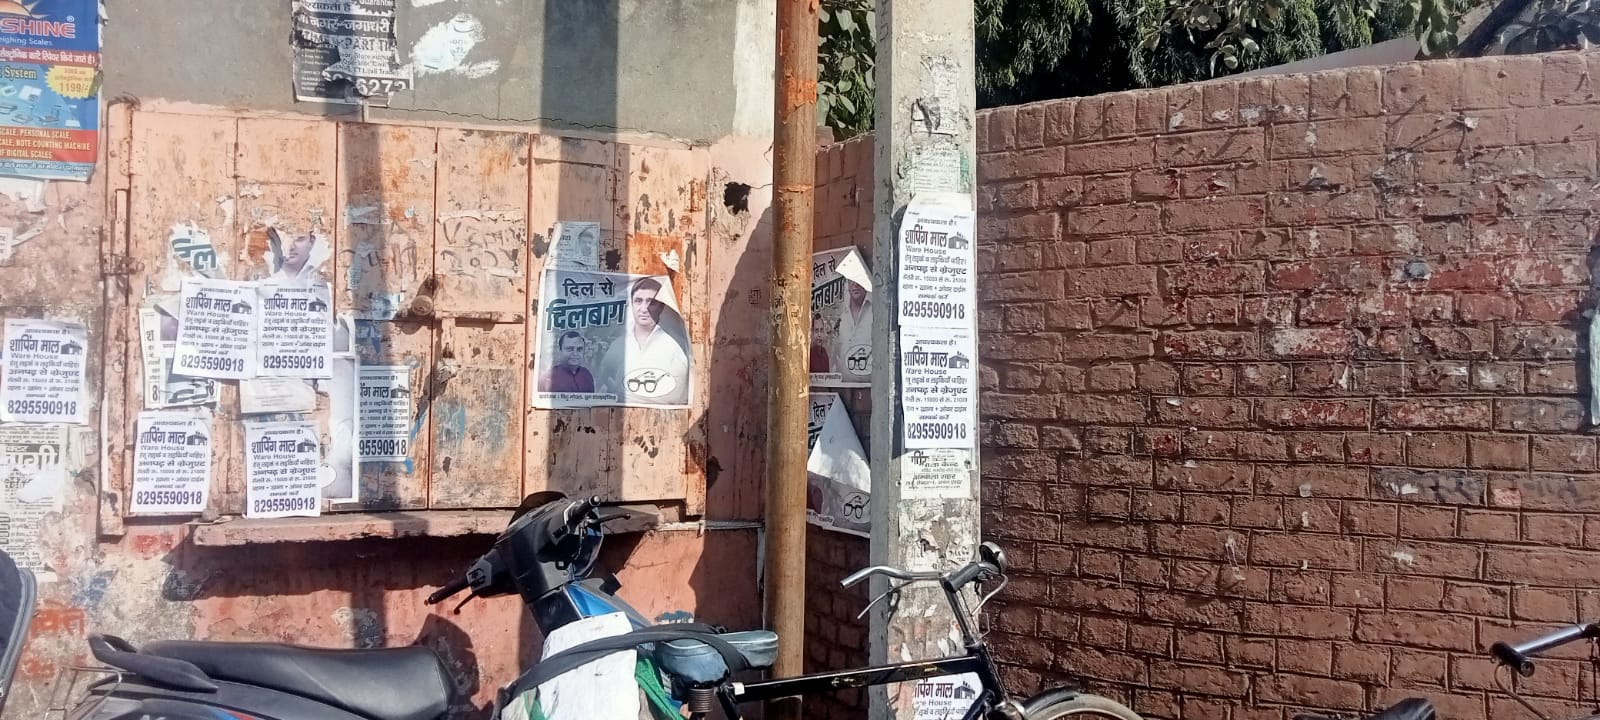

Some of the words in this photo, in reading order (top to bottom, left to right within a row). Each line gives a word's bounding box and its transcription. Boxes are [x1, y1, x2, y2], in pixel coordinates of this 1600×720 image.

[1, 19, 76, 39] SHINE
[29, 38, 52, 46] Scales
[4, 66, 37, 81] System
[20, 129, 50, 138] PERSONAL
[52, 130, 72, 140] SCALE,
[16, 139, 32, 148] NOTE
[33, 140, 61, 149] COUNTING
[63, 141, 91, 151] MACHINE
[7, 149, 29, 157] DIGITAL
[30, 150, 52, 159] SCALES
[930, 232, 948, 247] माल
[562, 278, 595, 297] दिल
[599, 277, 615, 297] से
[214, 298, 232, 311] माल
[291, 298, 307, 311] माल
[903, 301, 965, 319] 8295590918
[546, 298, 627, 332] दिलबाग
[40, 340, 61, 353] माल
[181, 355, 244, 372] 8295590918
[264, 356, 323, 369] 8295590918
[930, 353, 948, 367] माल
[372, 386, 390, 398] माल
[8, 400, 76, 415] 8295590918
[908, 423, 966, 439] 8295590918
[168, 432, 186, 444] माल
[279, 440, 296, 452] माल
[137, 491, 202, 504] 8295590918
[254, 497, 315, 512] 8295590918
[936, 683, 954, 698] माल
